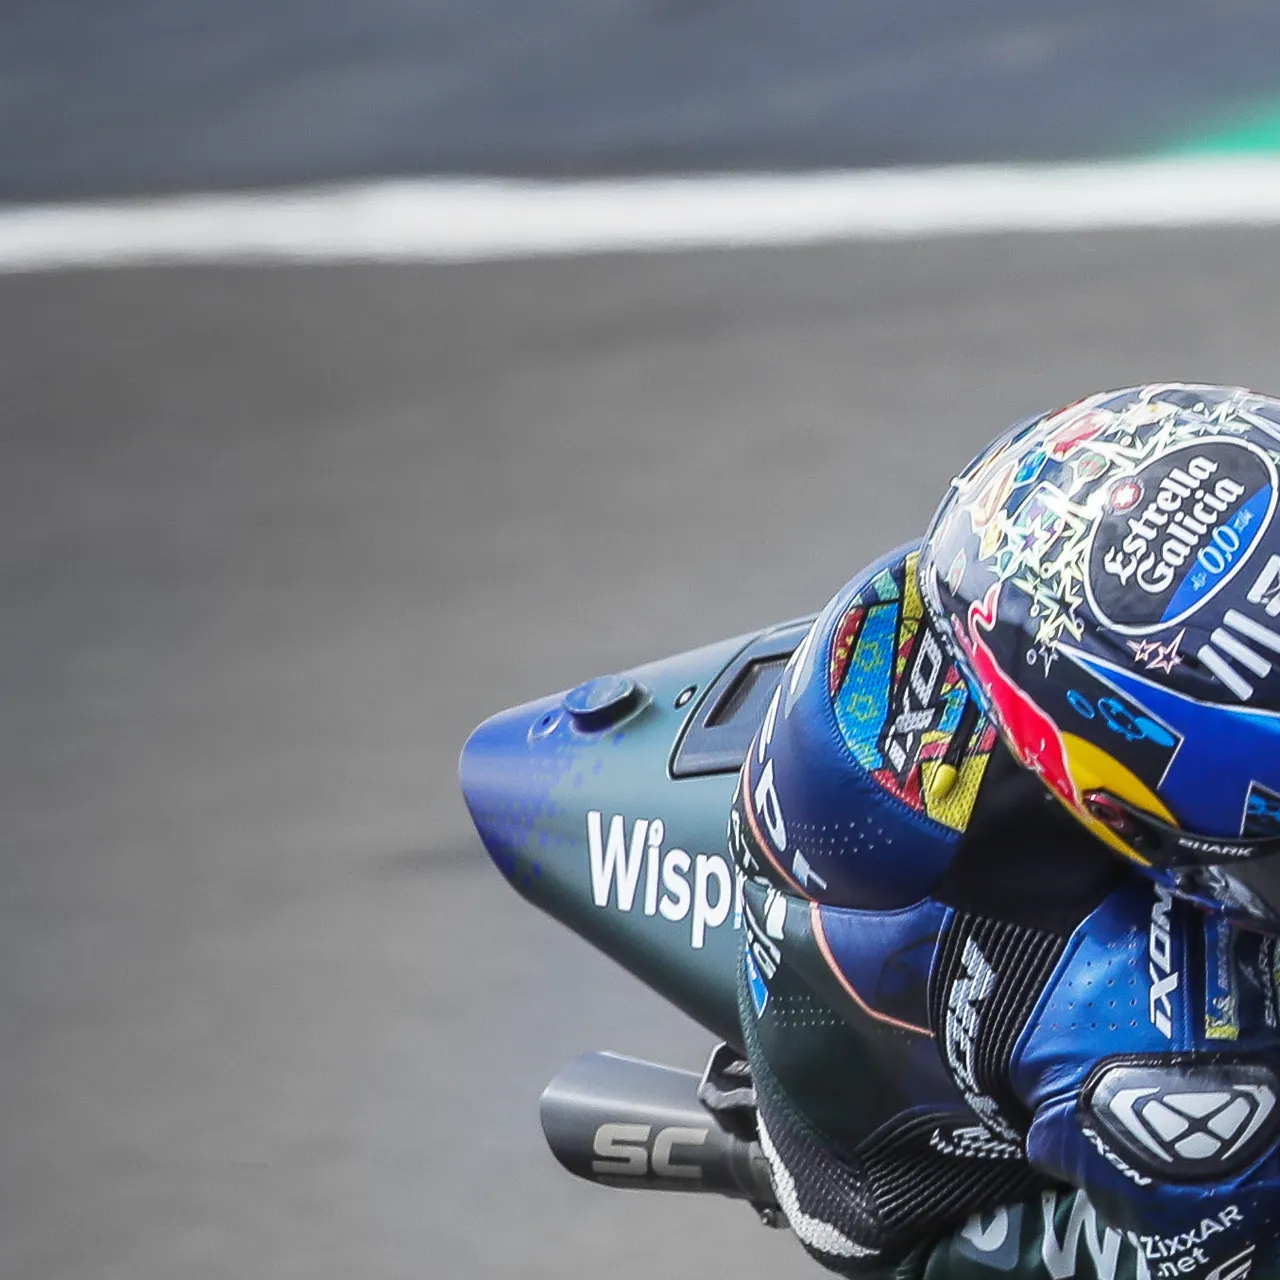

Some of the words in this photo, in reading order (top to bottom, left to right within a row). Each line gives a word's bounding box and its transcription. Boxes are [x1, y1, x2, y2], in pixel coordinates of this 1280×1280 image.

[1104, 456, 1218, 587] Estrella
[1137, 478, 1246, 594] Galicia
[591, 1122, 708, 1178] SC
[1082, 1126, 1153, 1187] IXON
